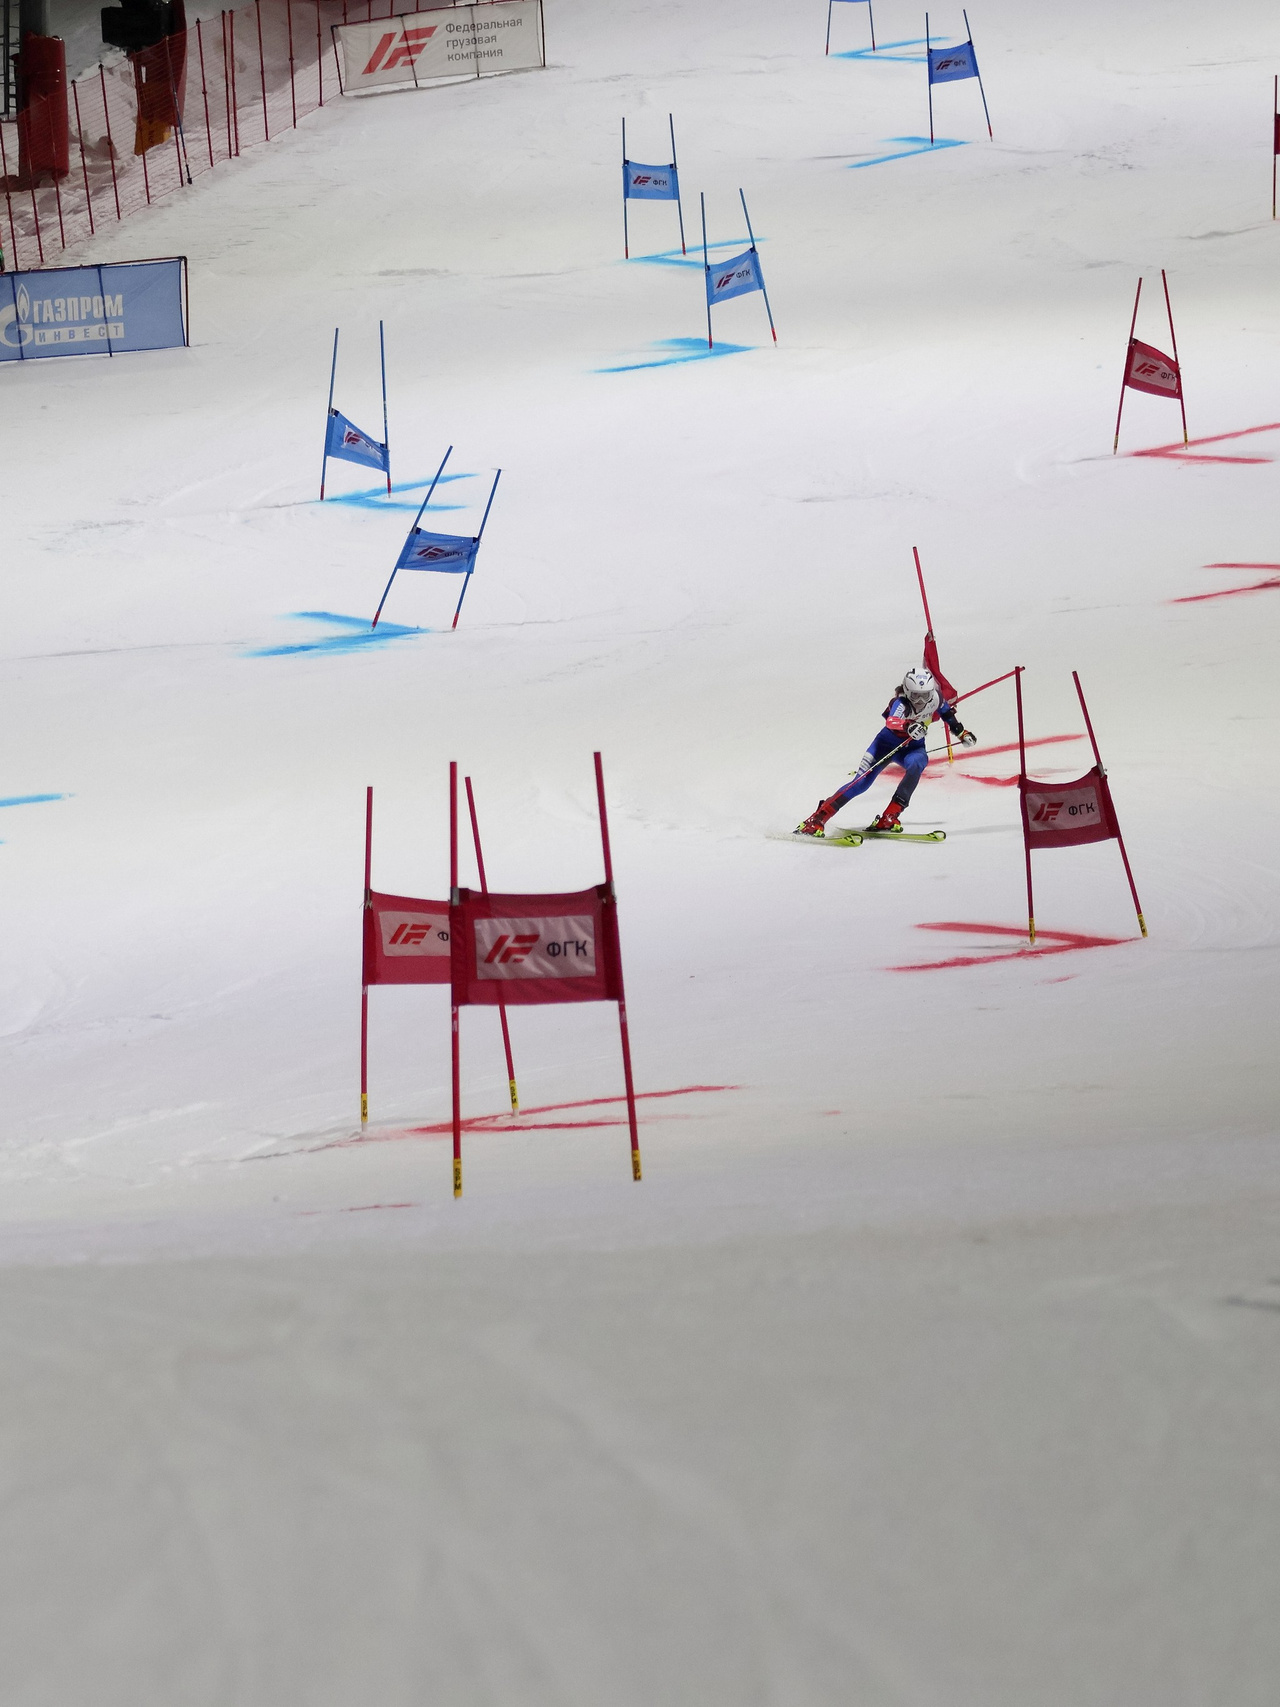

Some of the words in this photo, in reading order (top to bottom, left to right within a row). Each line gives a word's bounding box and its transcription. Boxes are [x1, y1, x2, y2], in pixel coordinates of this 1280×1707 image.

[445, 18, 523, 34] Федеральная
[446, 34, 497, 49] грузовая
[447, 48, 503, 62] компания
[736, 269, 751, 279] ФГК
[33, 294, 124, 324] ГАЗПРОМ
[38, 325, 121, 343] ИНВЕСТ
[1068, 802, 1095, 816] ФГК
[546, 940, 587, 958] ФГК
